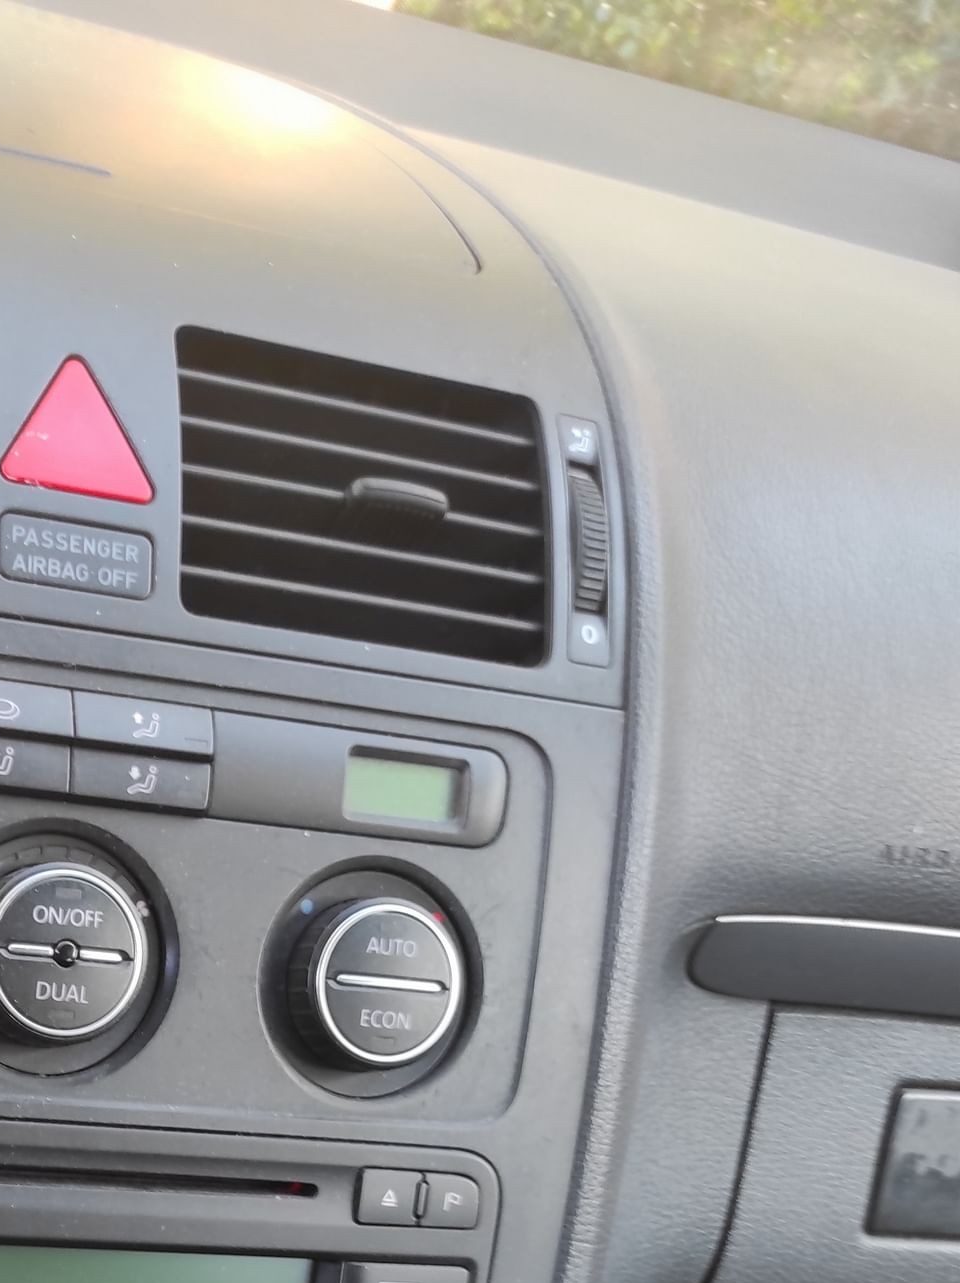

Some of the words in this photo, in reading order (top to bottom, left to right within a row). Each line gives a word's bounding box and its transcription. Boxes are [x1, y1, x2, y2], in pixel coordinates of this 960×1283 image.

[11, 523, 139, 564] PASSENGER
[11, 552, 89, 583] AIRBAG
[97, 566, 139, 589] OFF
[32, 904, 104, 929] ON/OFF
[365, 936, 418, 958] AUTO
[35, 980, 89, 1004] DUAL
[359, 1008, 411, 1030] ECON
